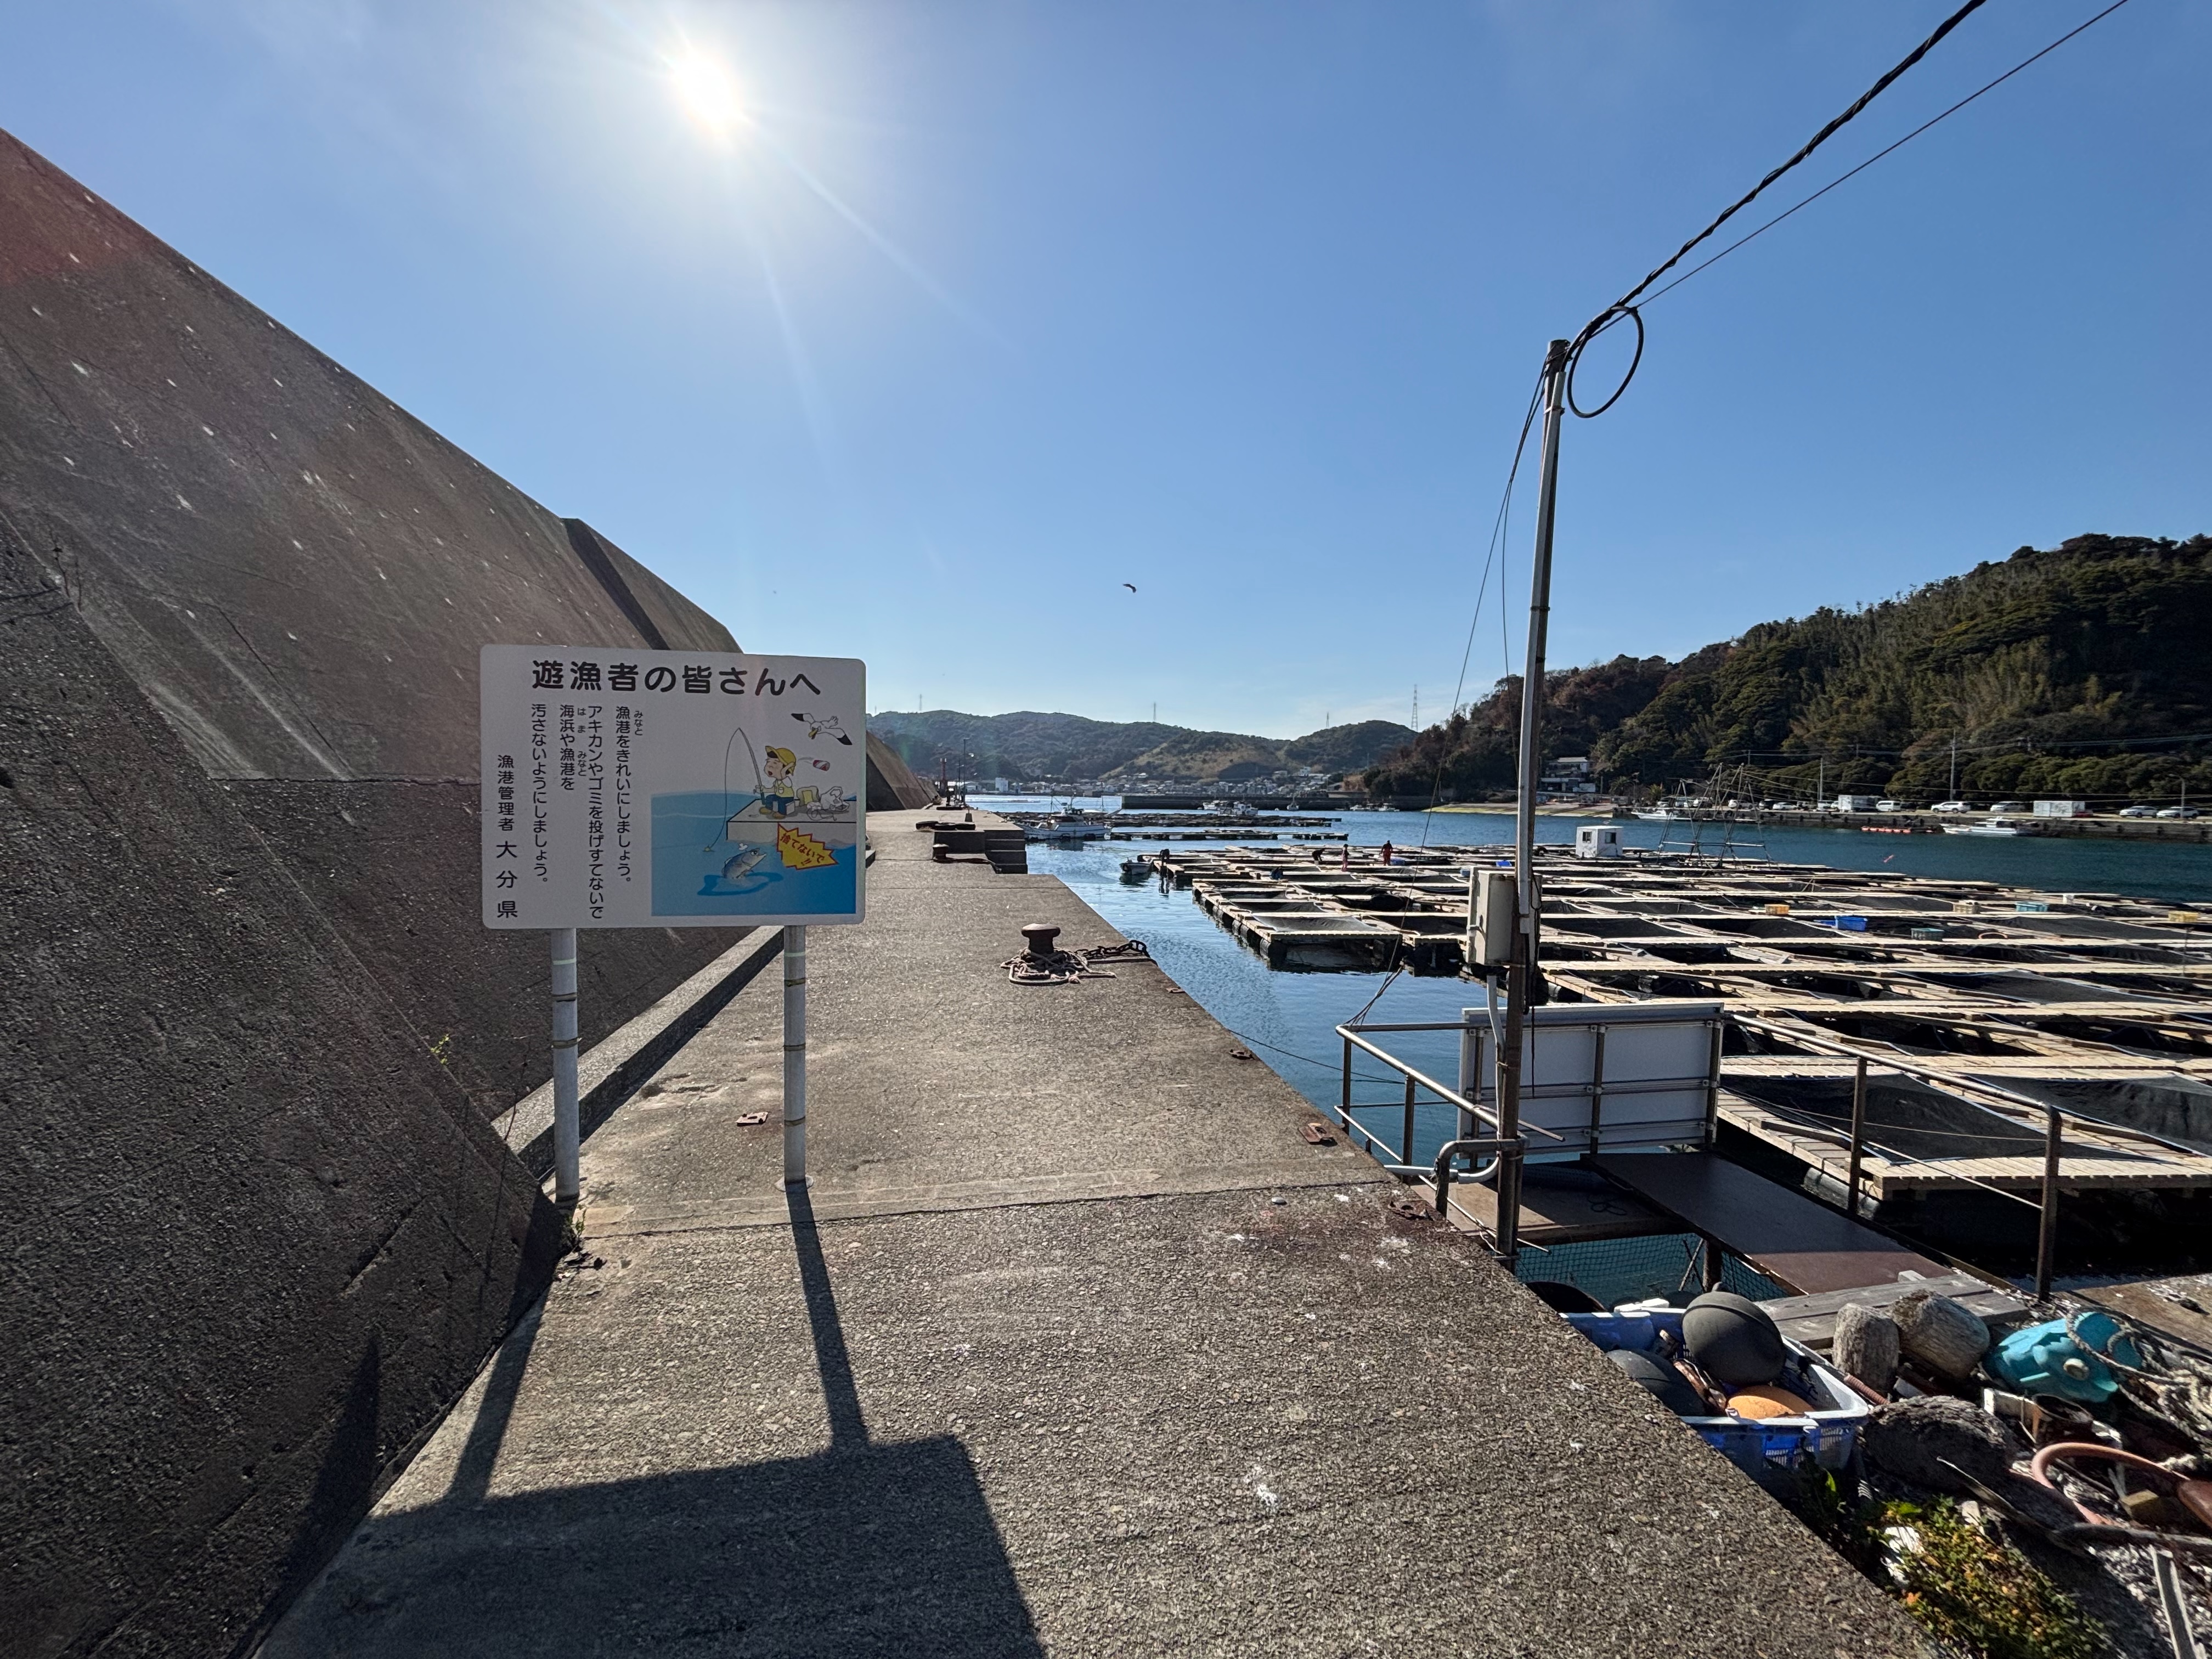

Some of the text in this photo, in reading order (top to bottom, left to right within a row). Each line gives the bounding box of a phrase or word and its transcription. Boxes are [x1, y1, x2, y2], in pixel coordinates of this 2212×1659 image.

[532, 660, 821, 696] 遊漁者の皆さんへ
[560, 704, 575, 791] 海浜や漁港を
[577, 751, 588, 777] みなと
[634, 710, 644, 736] みなと
[531, 704, 548, 882] 汚さないようにしましょう。
[588, 706, 604, 919] アキカンやゴミを投げすてないで
[616, 706, 631, 882] 漁港をきれいにしましょう。
